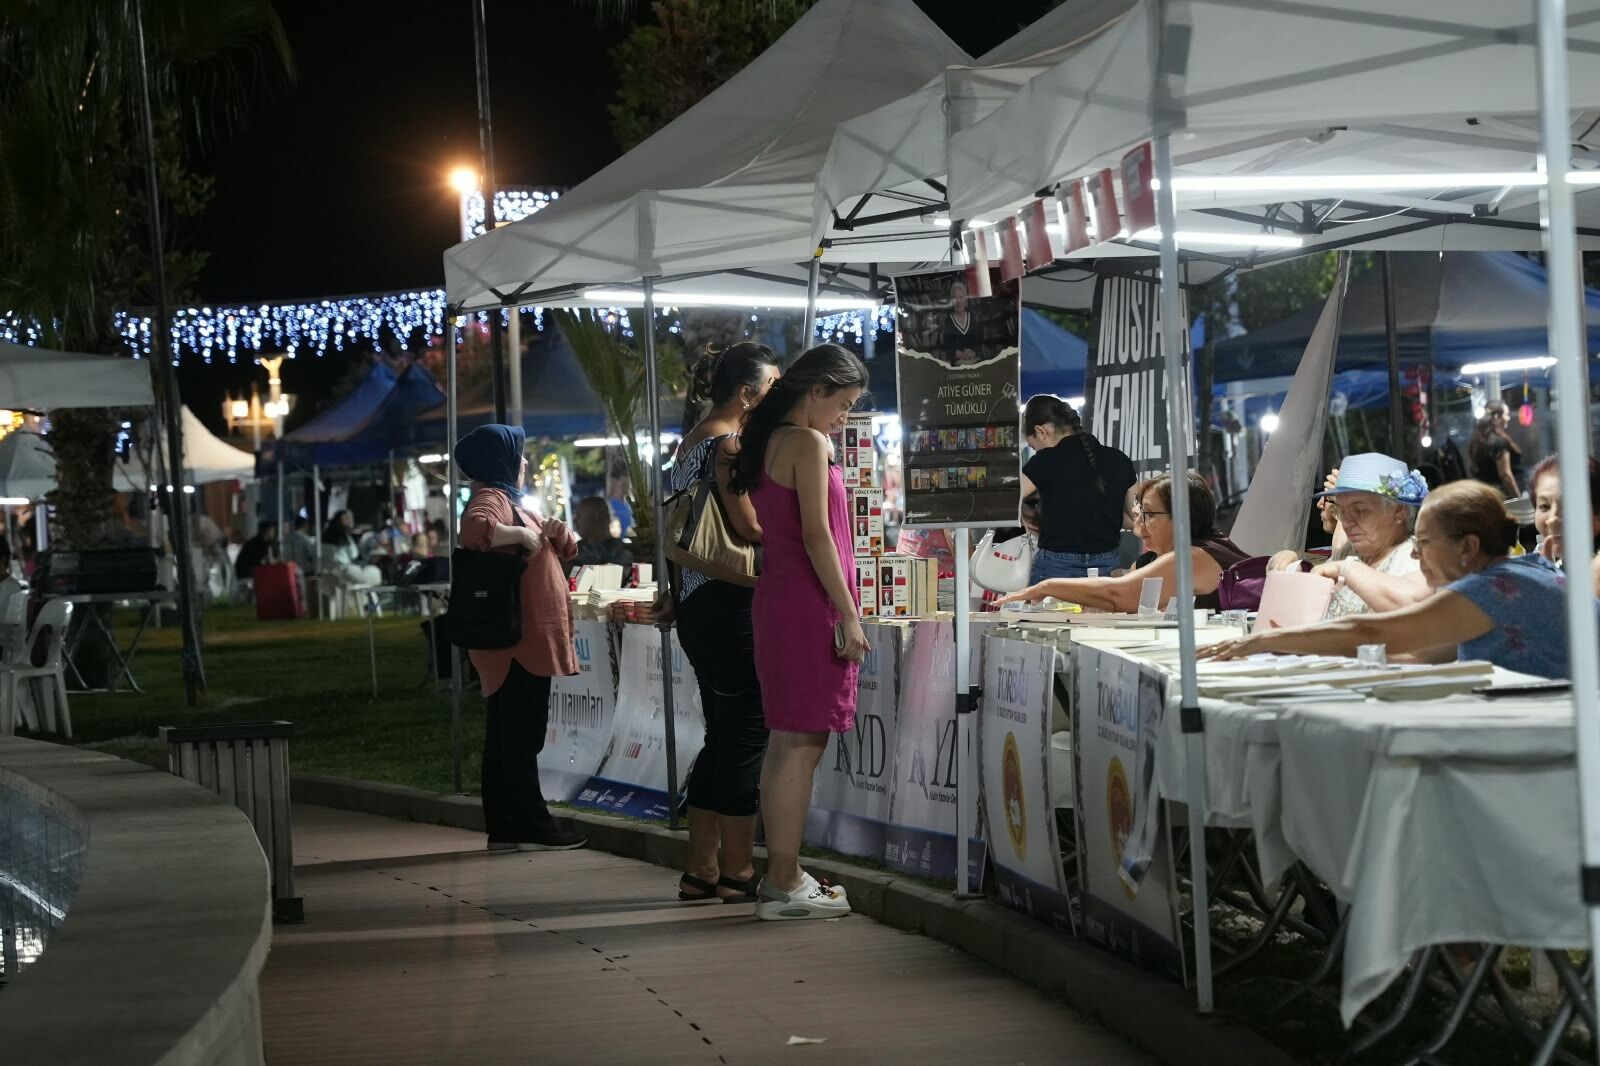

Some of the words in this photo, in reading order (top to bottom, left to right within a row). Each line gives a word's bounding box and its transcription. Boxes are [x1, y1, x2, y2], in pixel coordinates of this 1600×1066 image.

[1097, 276, 1190, 366] MUSTAA
[937, 384, 961, 398] ATİYE
[961, 383, 992, 397] GÜNER
[945, 402, 987, 416] TÜMÜKLÜ
